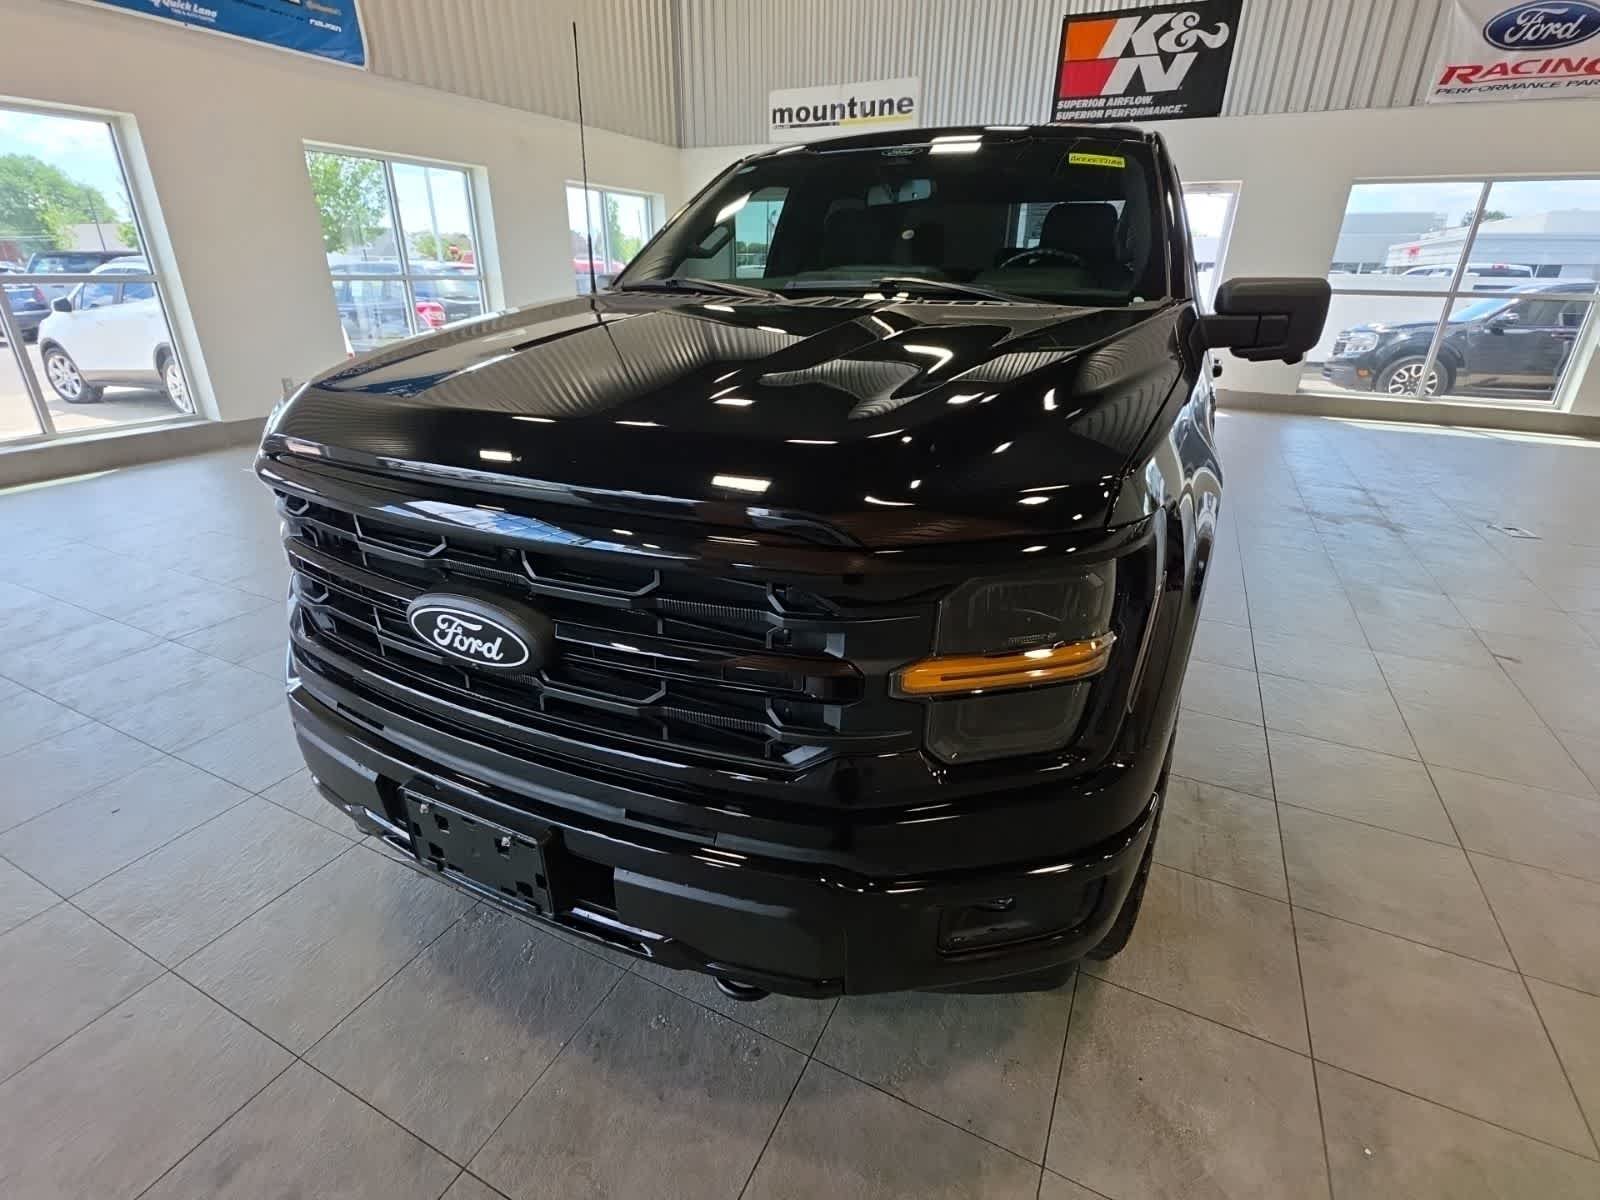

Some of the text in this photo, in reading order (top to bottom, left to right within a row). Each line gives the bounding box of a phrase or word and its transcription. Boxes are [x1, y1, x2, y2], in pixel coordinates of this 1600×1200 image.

[1504, 8, 1587, 44] Ford
[1435, 80, 1560, 95] PERFORMANCE
[772, 96, 914, 124] mountune
[1057, 98, 1105, 110] SUPERIOR
[1056, 109, 1105, 121] SUPERIOR
[433, 614, 504, 660] Ford
